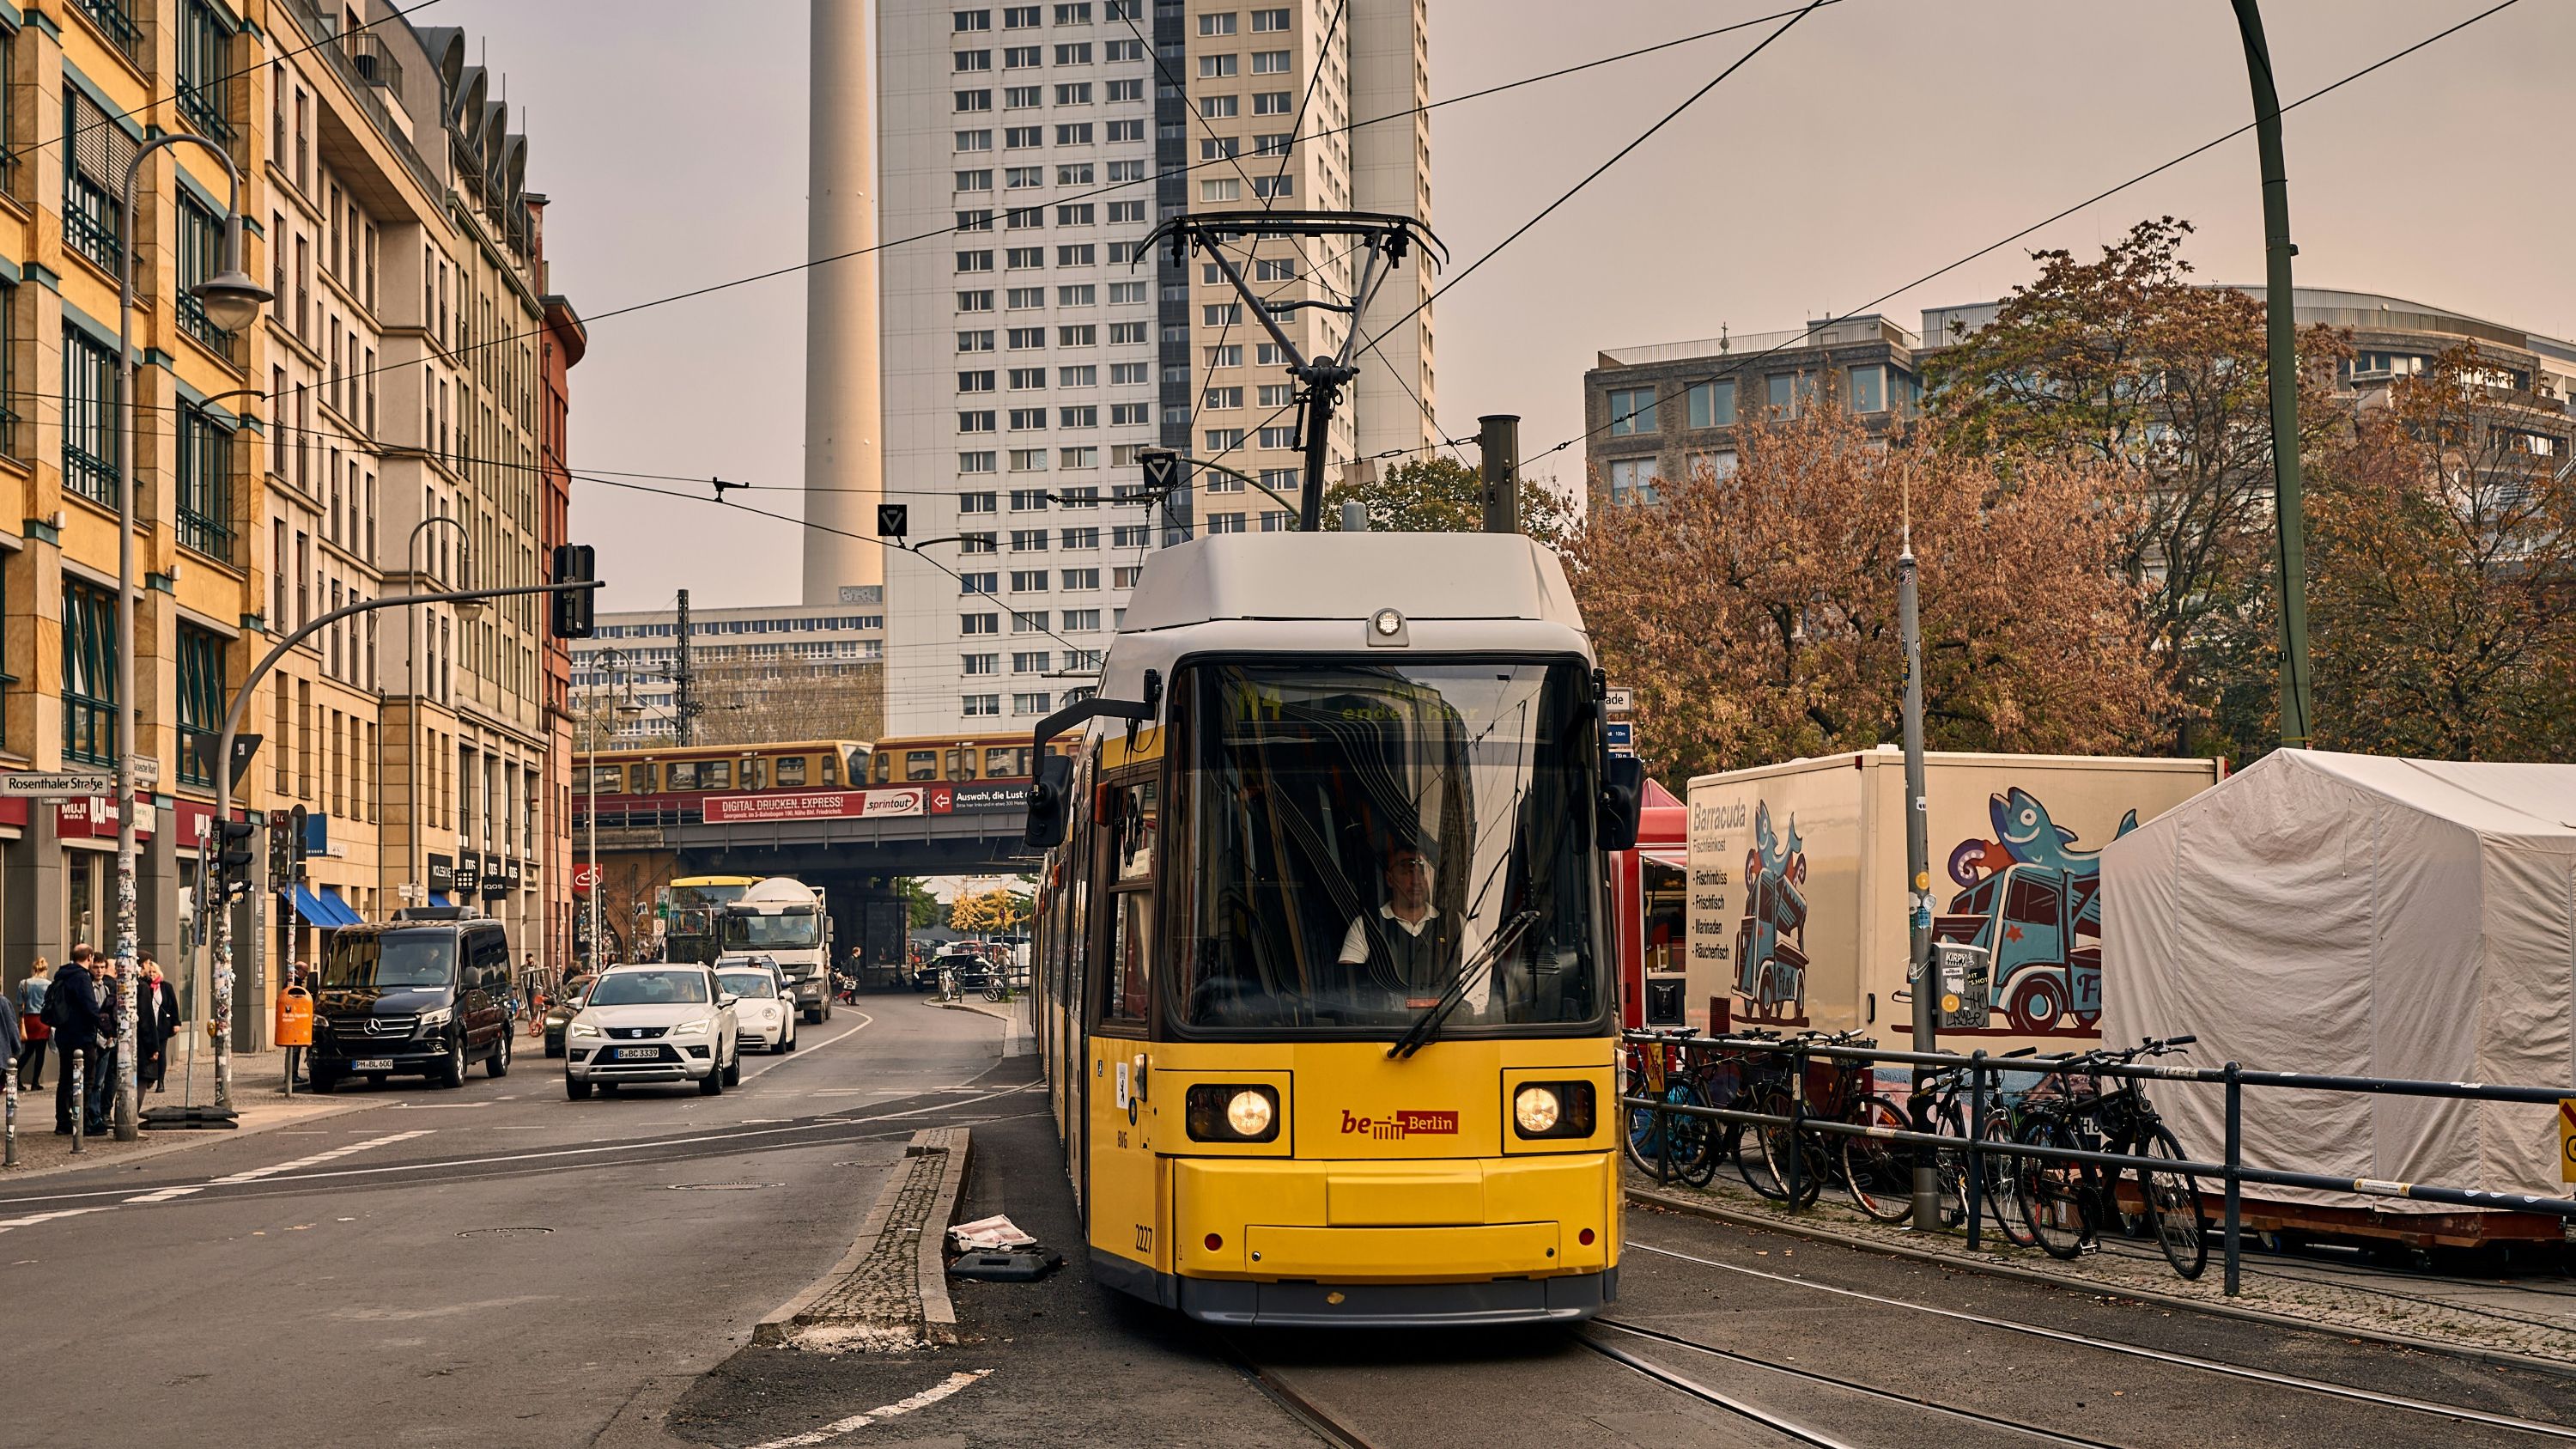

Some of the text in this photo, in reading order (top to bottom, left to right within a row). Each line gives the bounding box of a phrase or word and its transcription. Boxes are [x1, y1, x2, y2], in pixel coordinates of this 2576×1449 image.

[1605, 693, 1624, 705] ade
[9, 776, 104, 792] Rosenthaler Straße
[956, 791, 991, 801] Auswahl,
[992, 791, 1005, 800] die
[1005, 790, 1024, 799] Lust
[61, 803, 87, 814] MUJI
[722, 796, 844, 812] DIGITAL DRUCKEN. EXPRESS!
[867, 799, 912, 811] sprintout
[1693, 797, 1746, 831] Barracuda
[1693, 837, 1726, 854] Fischfeinkost
[1696, 870, 1728, 886] Fischimbiss
[1695, 894, 1725, 910] Frischfisch
[1695, 918, 1722, 935] Marinaden
[1695, 943, 1729, 960] Räucherfisch
[1777, 967, 1795, 997] Fish
[640, 1049, 658, 1057] 3339
[1341, 1110, 1453, 1134] be Berlin
[1118, 1130, 1127, 1149] BVG
[1135, 1223, 1152, 1254] 2227
